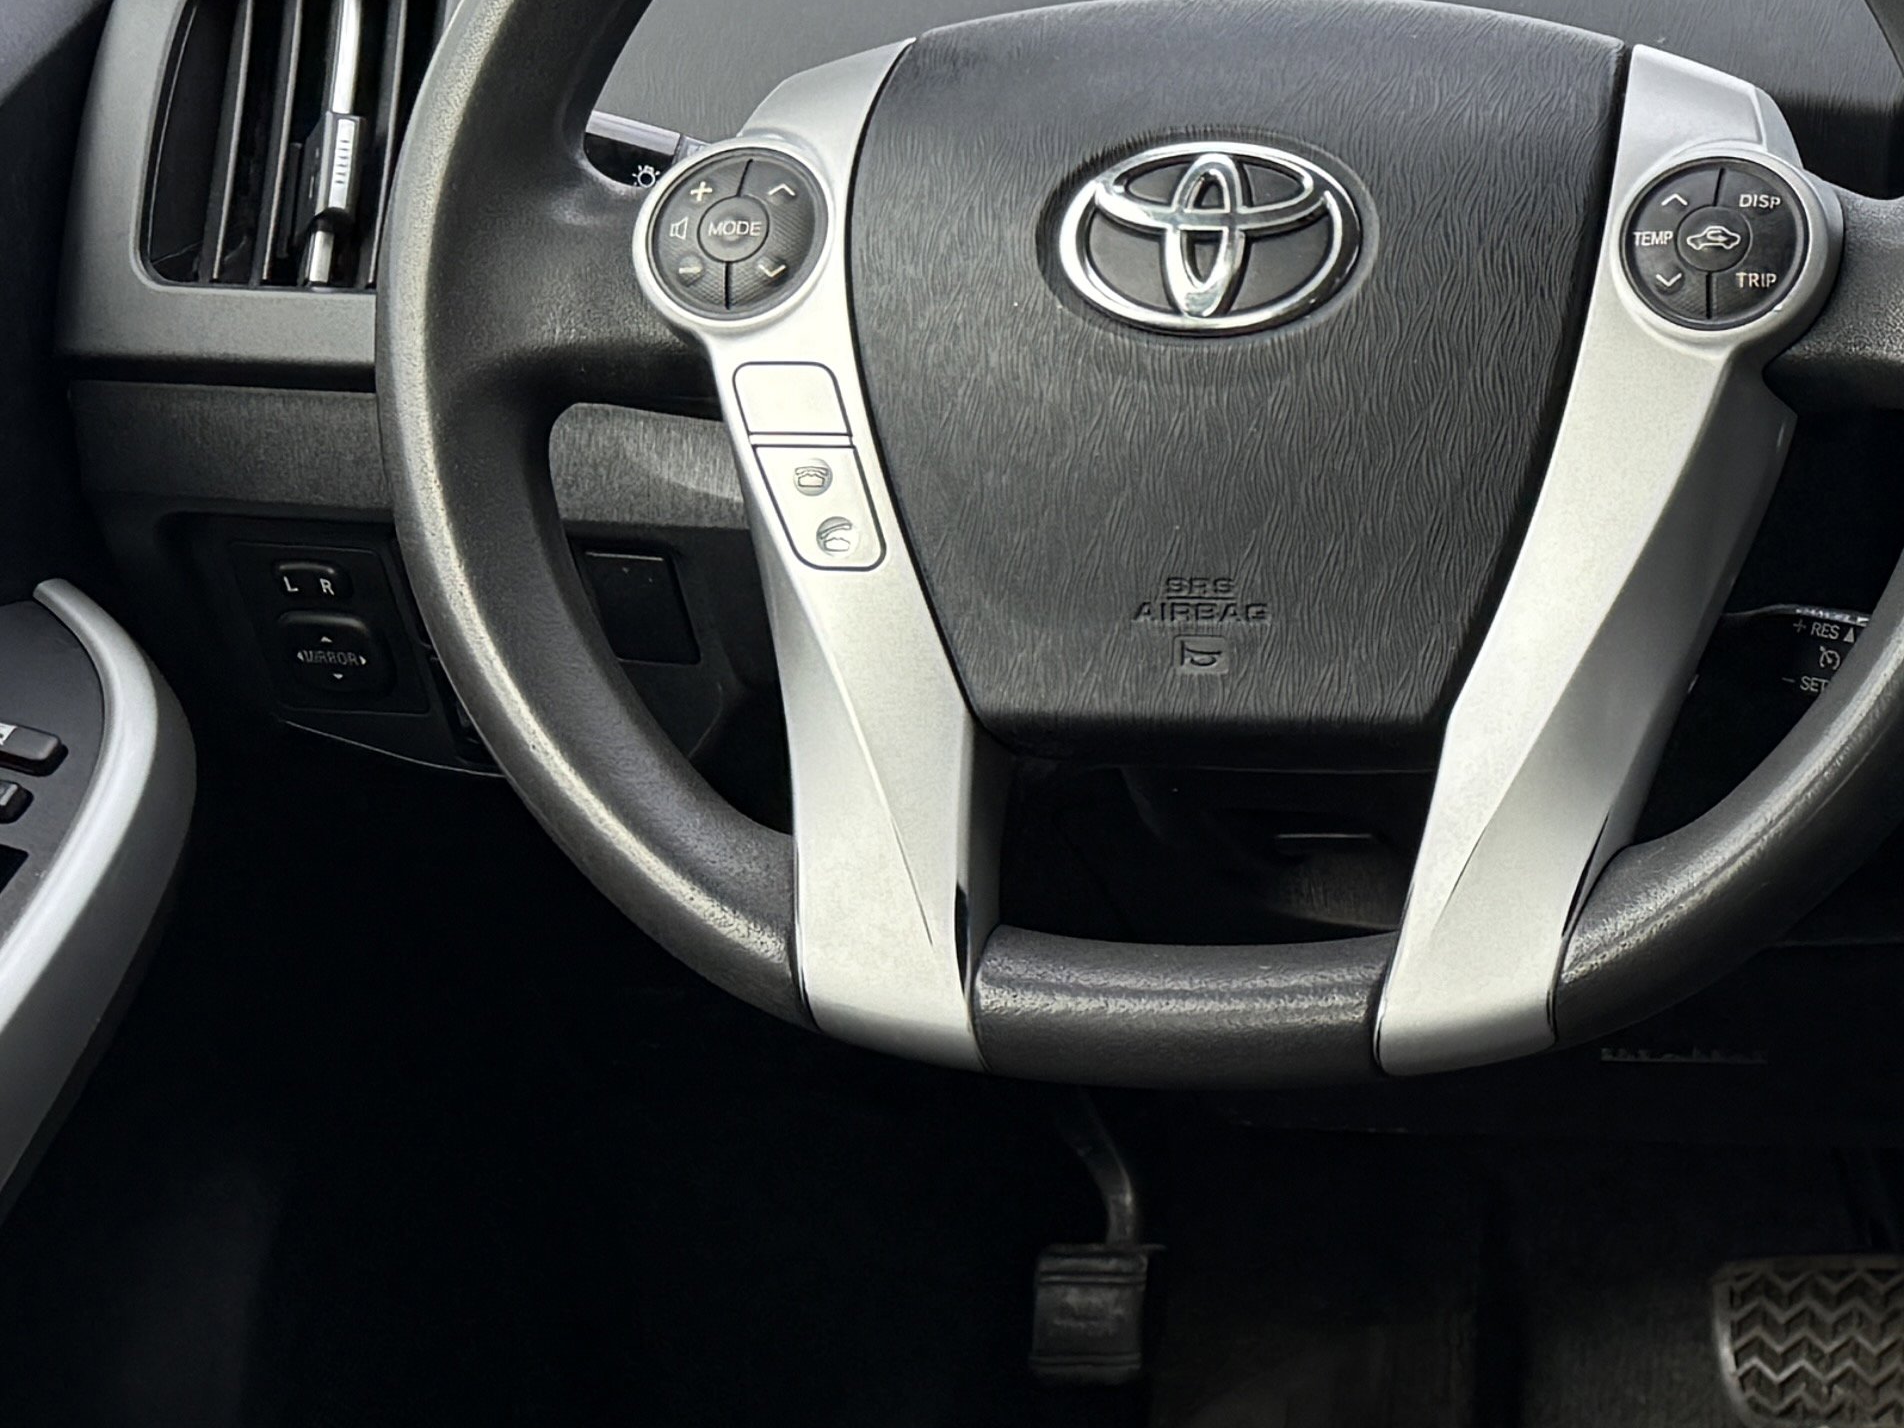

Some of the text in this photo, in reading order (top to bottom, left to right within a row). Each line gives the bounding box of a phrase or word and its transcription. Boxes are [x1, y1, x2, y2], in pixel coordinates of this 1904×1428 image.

[1738, 193, 1781, 210] DISP
[707, 219, 762, 238] MODE
[1633, 230, 1674, 247] TEMP
[1735, 272, 1777, 289] TRIP
[282, 575, 299, 593] L
[319, 577, 335, 596] R
[1164, 576, 1237, 595] SRS
[1132, 600, 1271, 623] AIRBAG
[1810, 621, 1841, 640] RES
[1799, 675, 1830, 692] SET
